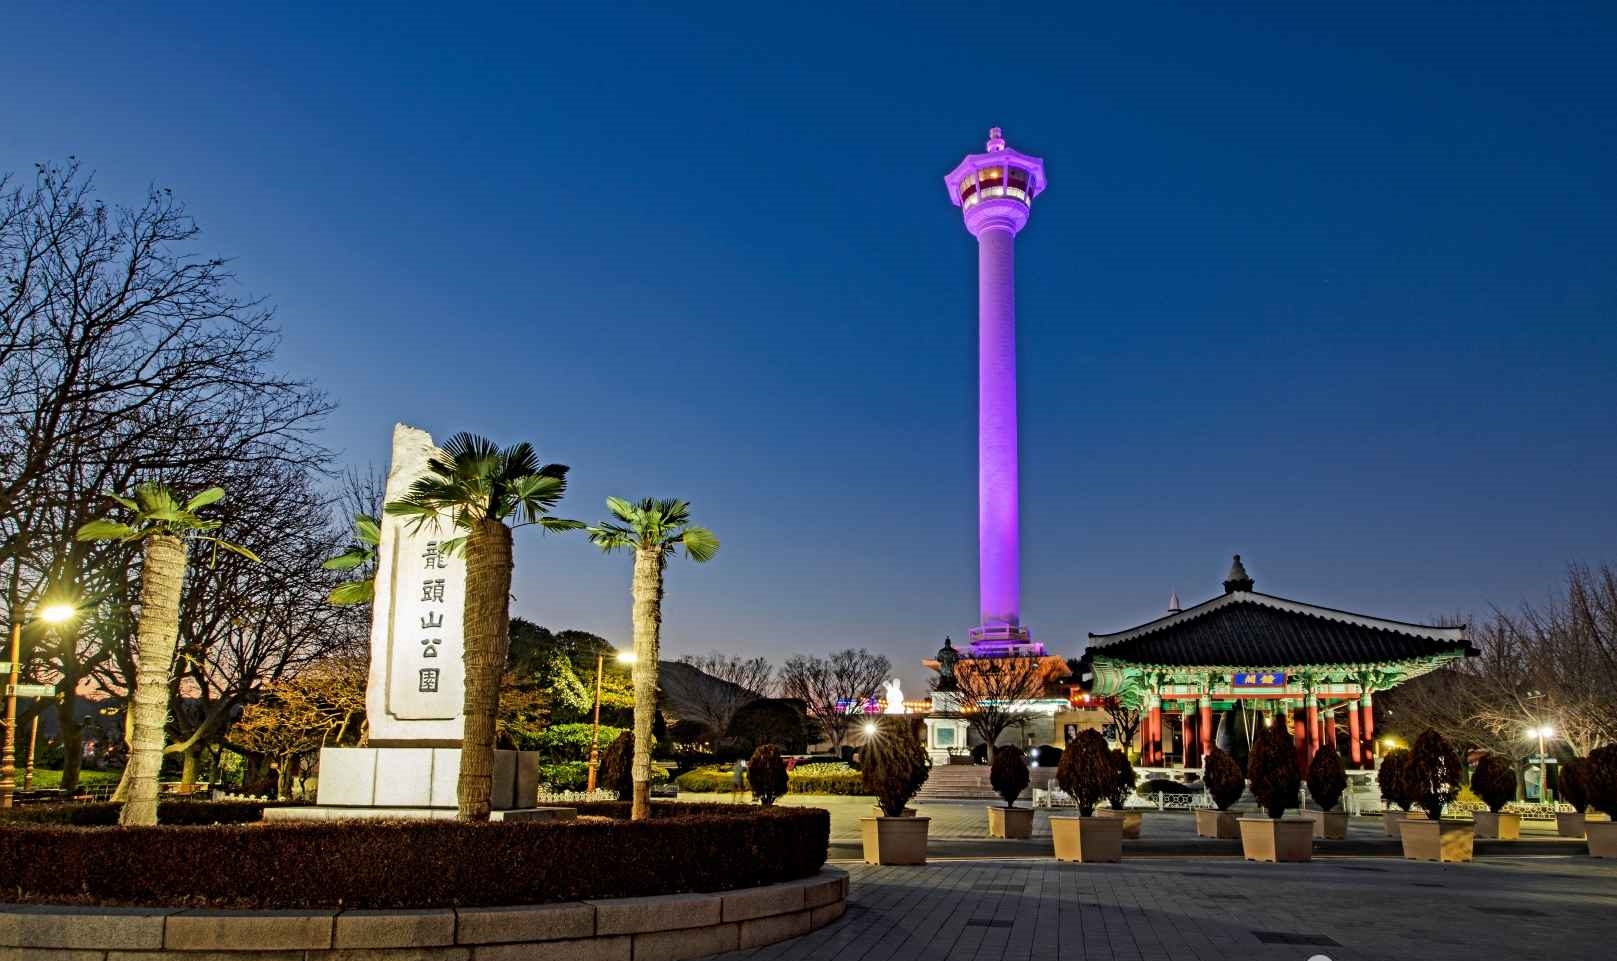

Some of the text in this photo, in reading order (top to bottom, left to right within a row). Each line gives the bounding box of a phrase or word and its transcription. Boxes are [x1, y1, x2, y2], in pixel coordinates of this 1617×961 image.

[418, 541, 448, 692] 龍頭山公園
